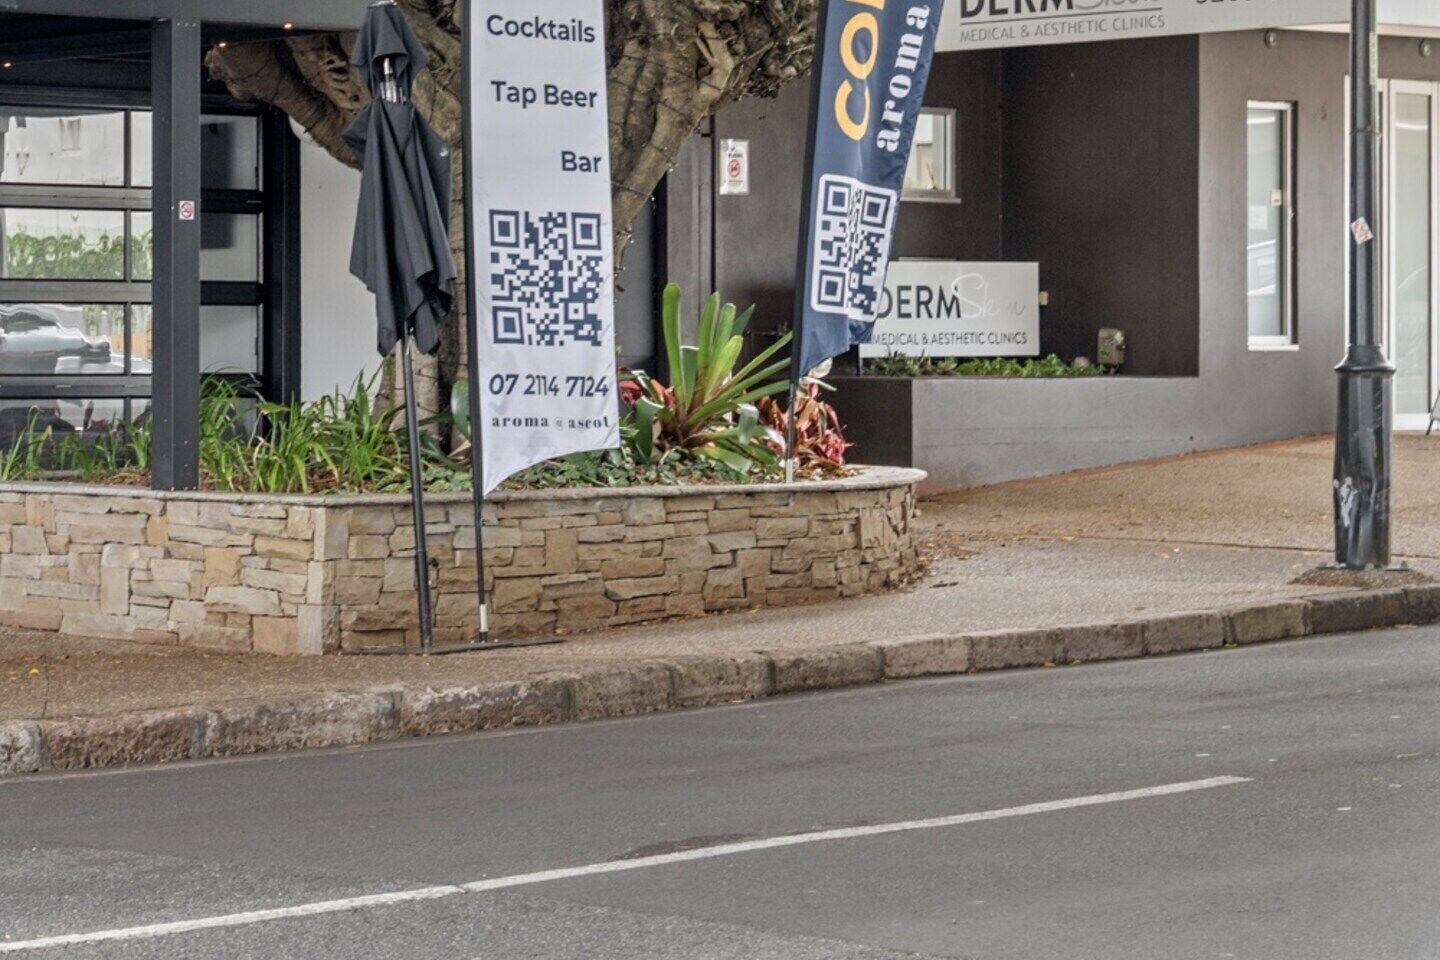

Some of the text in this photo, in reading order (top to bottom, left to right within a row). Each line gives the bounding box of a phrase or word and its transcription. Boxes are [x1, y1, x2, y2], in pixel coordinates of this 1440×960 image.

[486, 14, 596, 43] Cocktails
[960, 14, 1166, 43] MEDICAL & AESTHETIC CLINICS
[876, 4, 931, 153] aroma
[490, 80, 598, 109] Tap Beer
[561, 150, 602, 173] Bar
[922, 333, 929, 346] &
[931, 331, 985, 345] AESTHETIC
[987, 330, 1028, 345] CLINICS
[488, 373, 609, 397] 07 2114 7124
[492, 416, 549, 428] aroma
[568, 416, 610, 430] ascot
